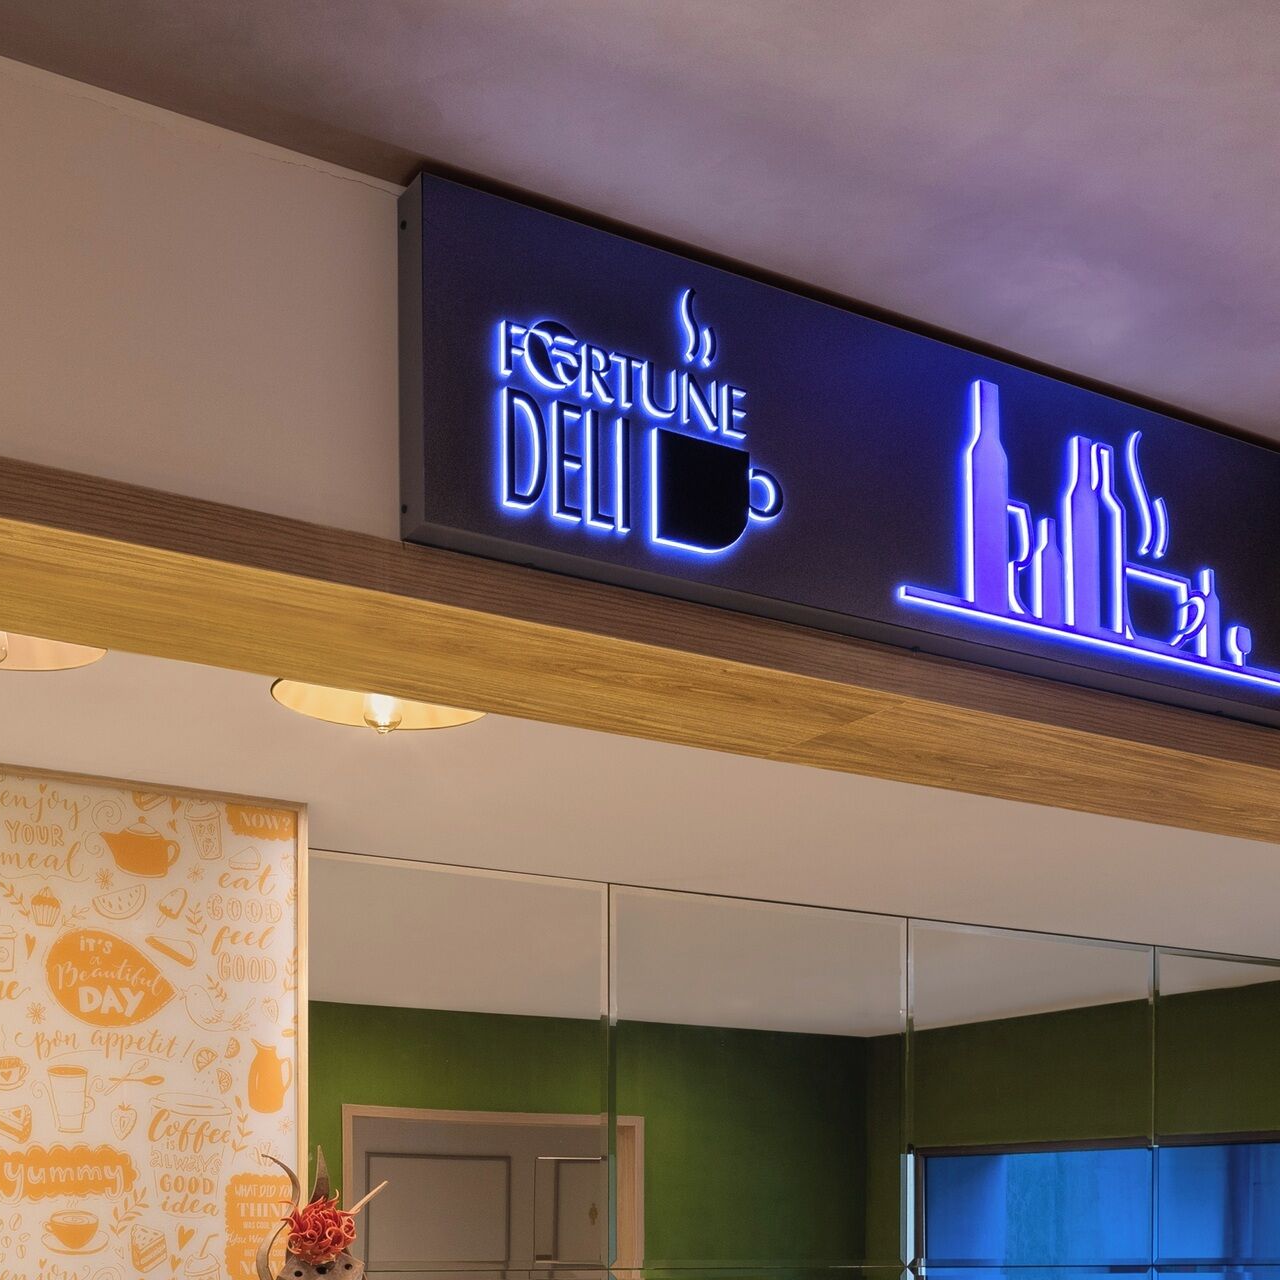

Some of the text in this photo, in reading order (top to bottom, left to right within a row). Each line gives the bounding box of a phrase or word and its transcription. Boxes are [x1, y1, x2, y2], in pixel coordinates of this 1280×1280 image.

[499, 319, 747, 440] FORTUNE
[497, 386, 631, 535] DELI
[4, 819, 65, 847] YOUR
[238, 811, 291, 832] NOW?
[219, 864, 278, 896] eat
[206, 893, 282, 924] GOOD
[211, 925, 276, 956] feel
[217, 951, 278, 984] GOOD
[78, 985, 145, 1018] DAY
[147, 1108, 232, 1153] Coffee
[3, 1161, 125, 1201] yummy
[159, 1174, 214, 1196] GOOD
[161, 1198, 220, 1217] idea
